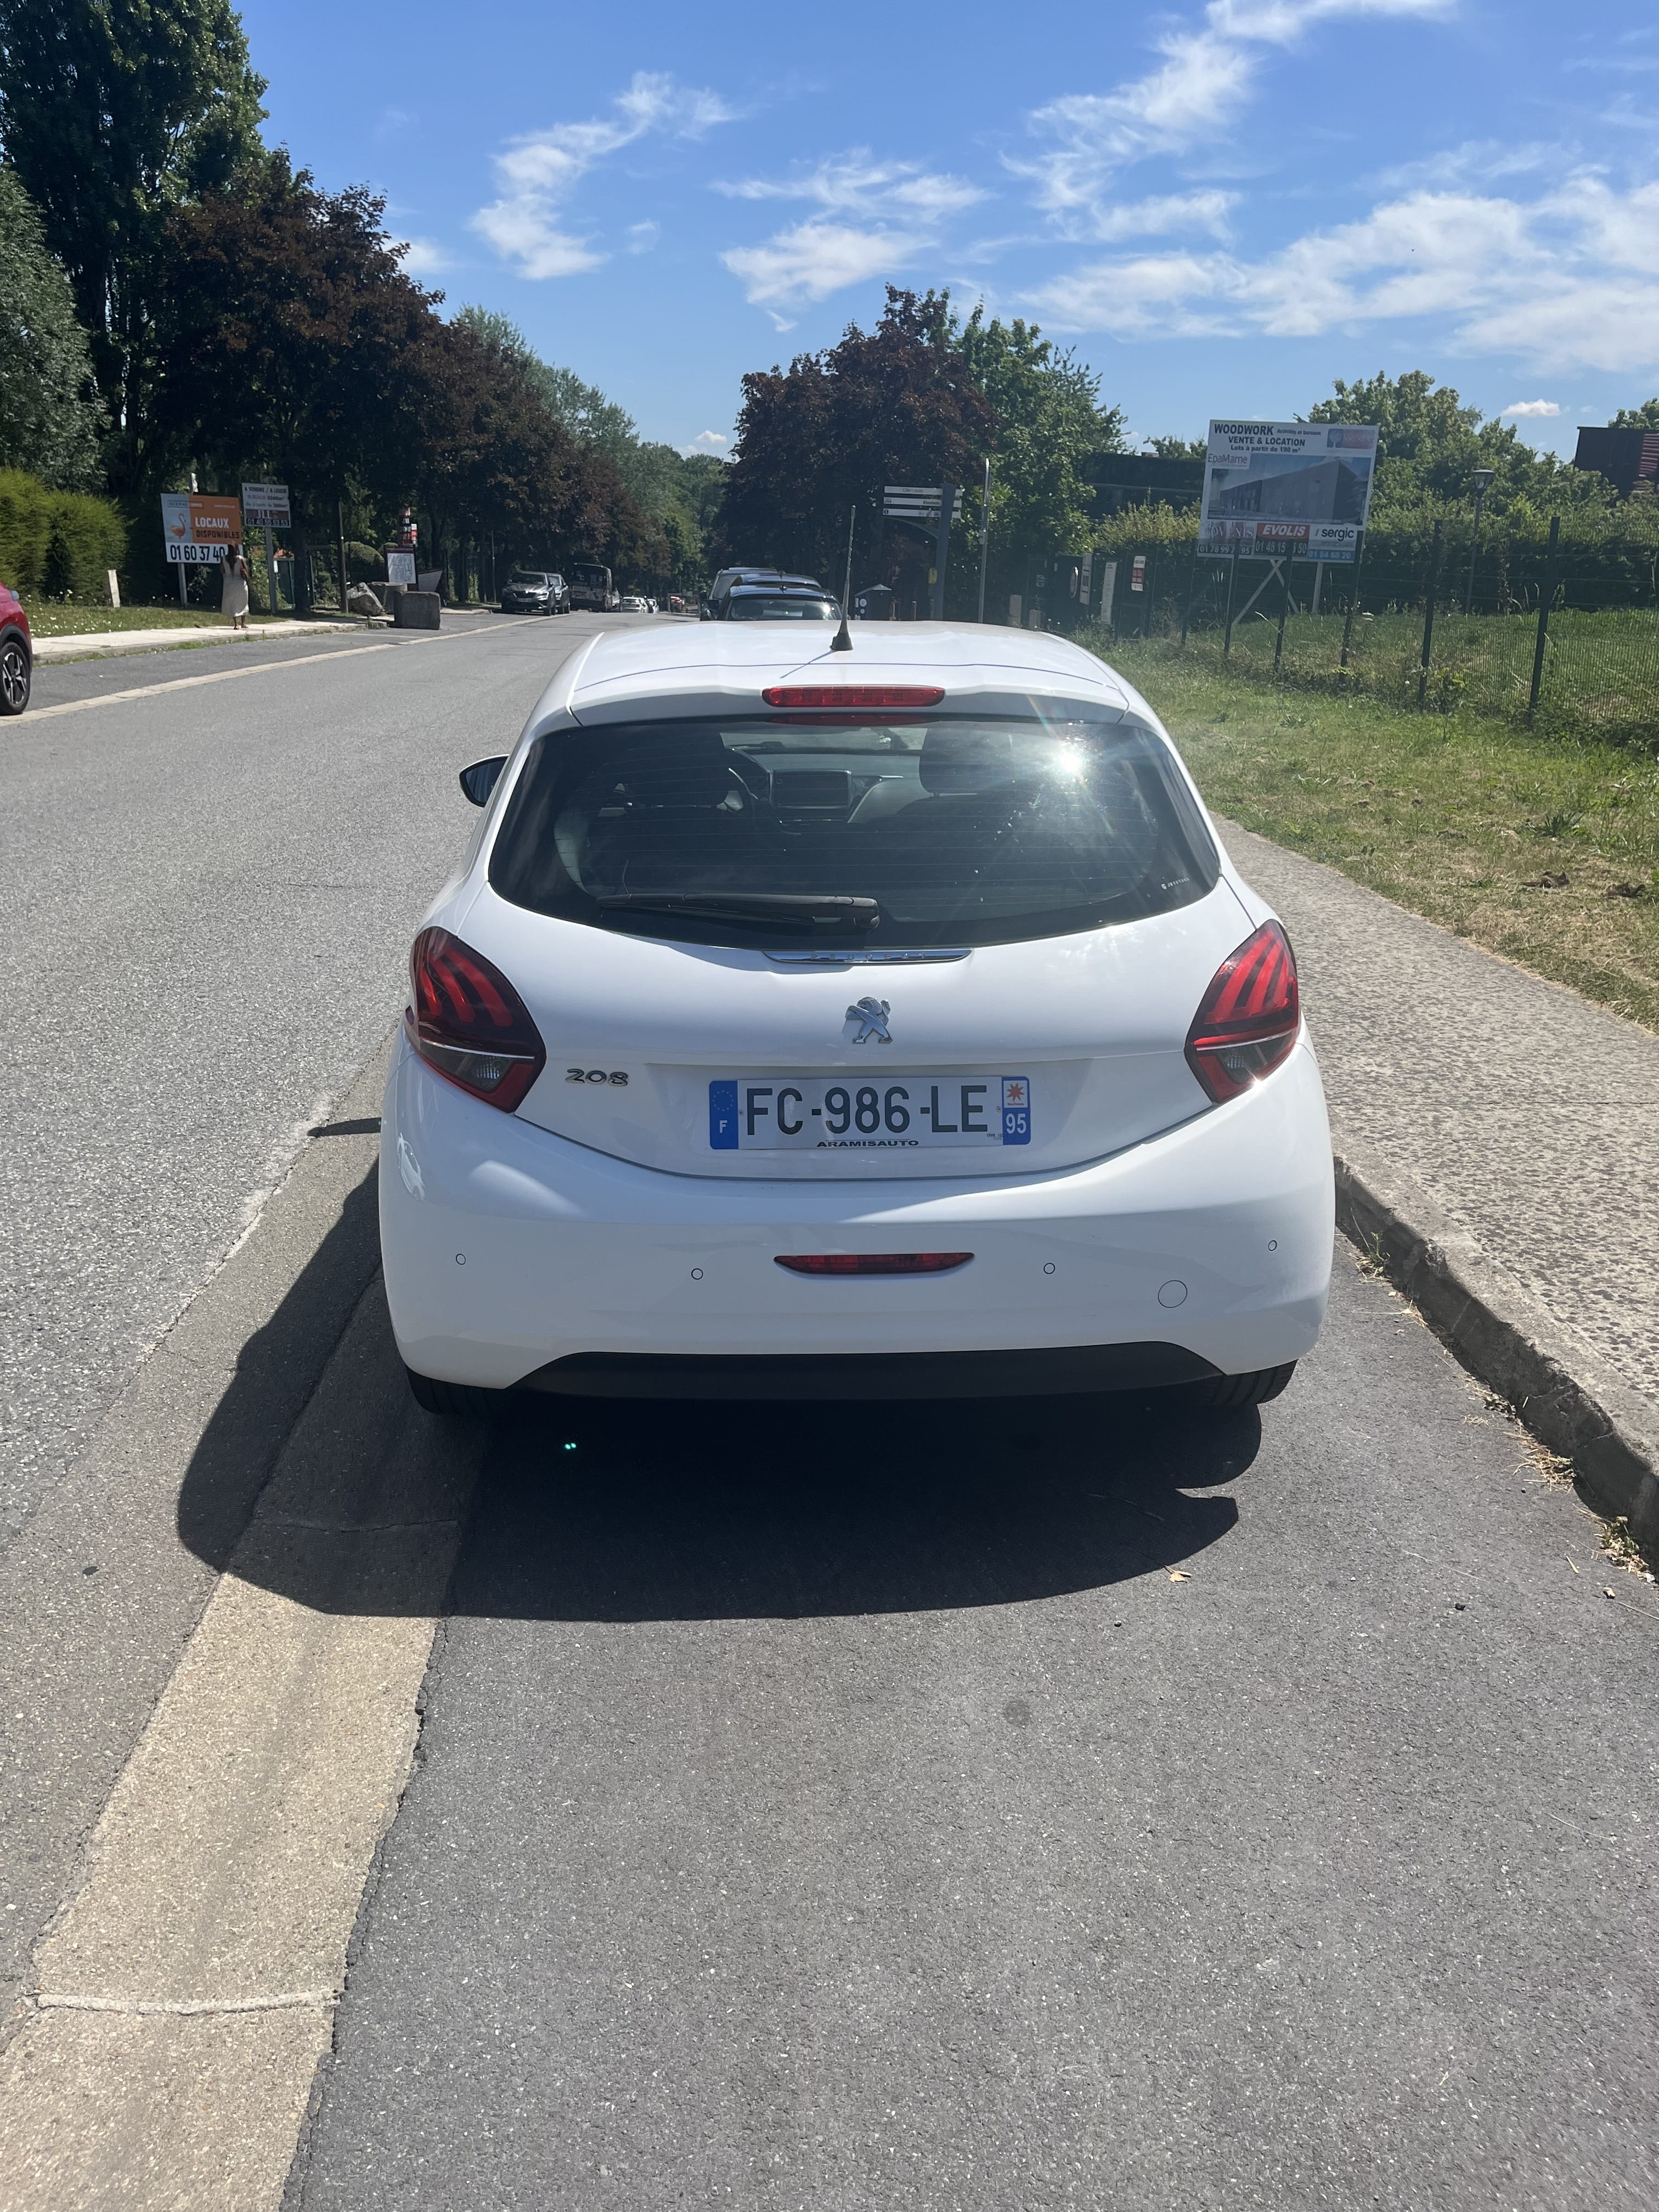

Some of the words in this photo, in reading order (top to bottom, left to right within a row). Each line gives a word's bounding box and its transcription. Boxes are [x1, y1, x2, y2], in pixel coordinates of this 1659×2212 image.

[1214, 424, 1274, 436] WOODWORK
[1265, 437, 1305, 447] LOCATION
[1208, 454, 1248, 465] EpaMarne
[256, 509, 272, 519] JLL
[195, 517, 229, 528] LOCAUX
[196, 530, 240, 539] DISPONIBLES
[1263, 524, 1306, 537] EVOLIS
[1321, 527, 1354, 541] sergic
[170, 544, 182, 561] 01
[184, 545, 197, 561] 60
[199, 545, 210, 561] 37
[1256, 541, 1265, 552] 01
[565, 1069, 629, 1087] 208
[746, 1085, 988, 1136] FC-986-LE
[719, 1120, 727, 1134] F
[1006, 1113, 1027, 1134] 95
